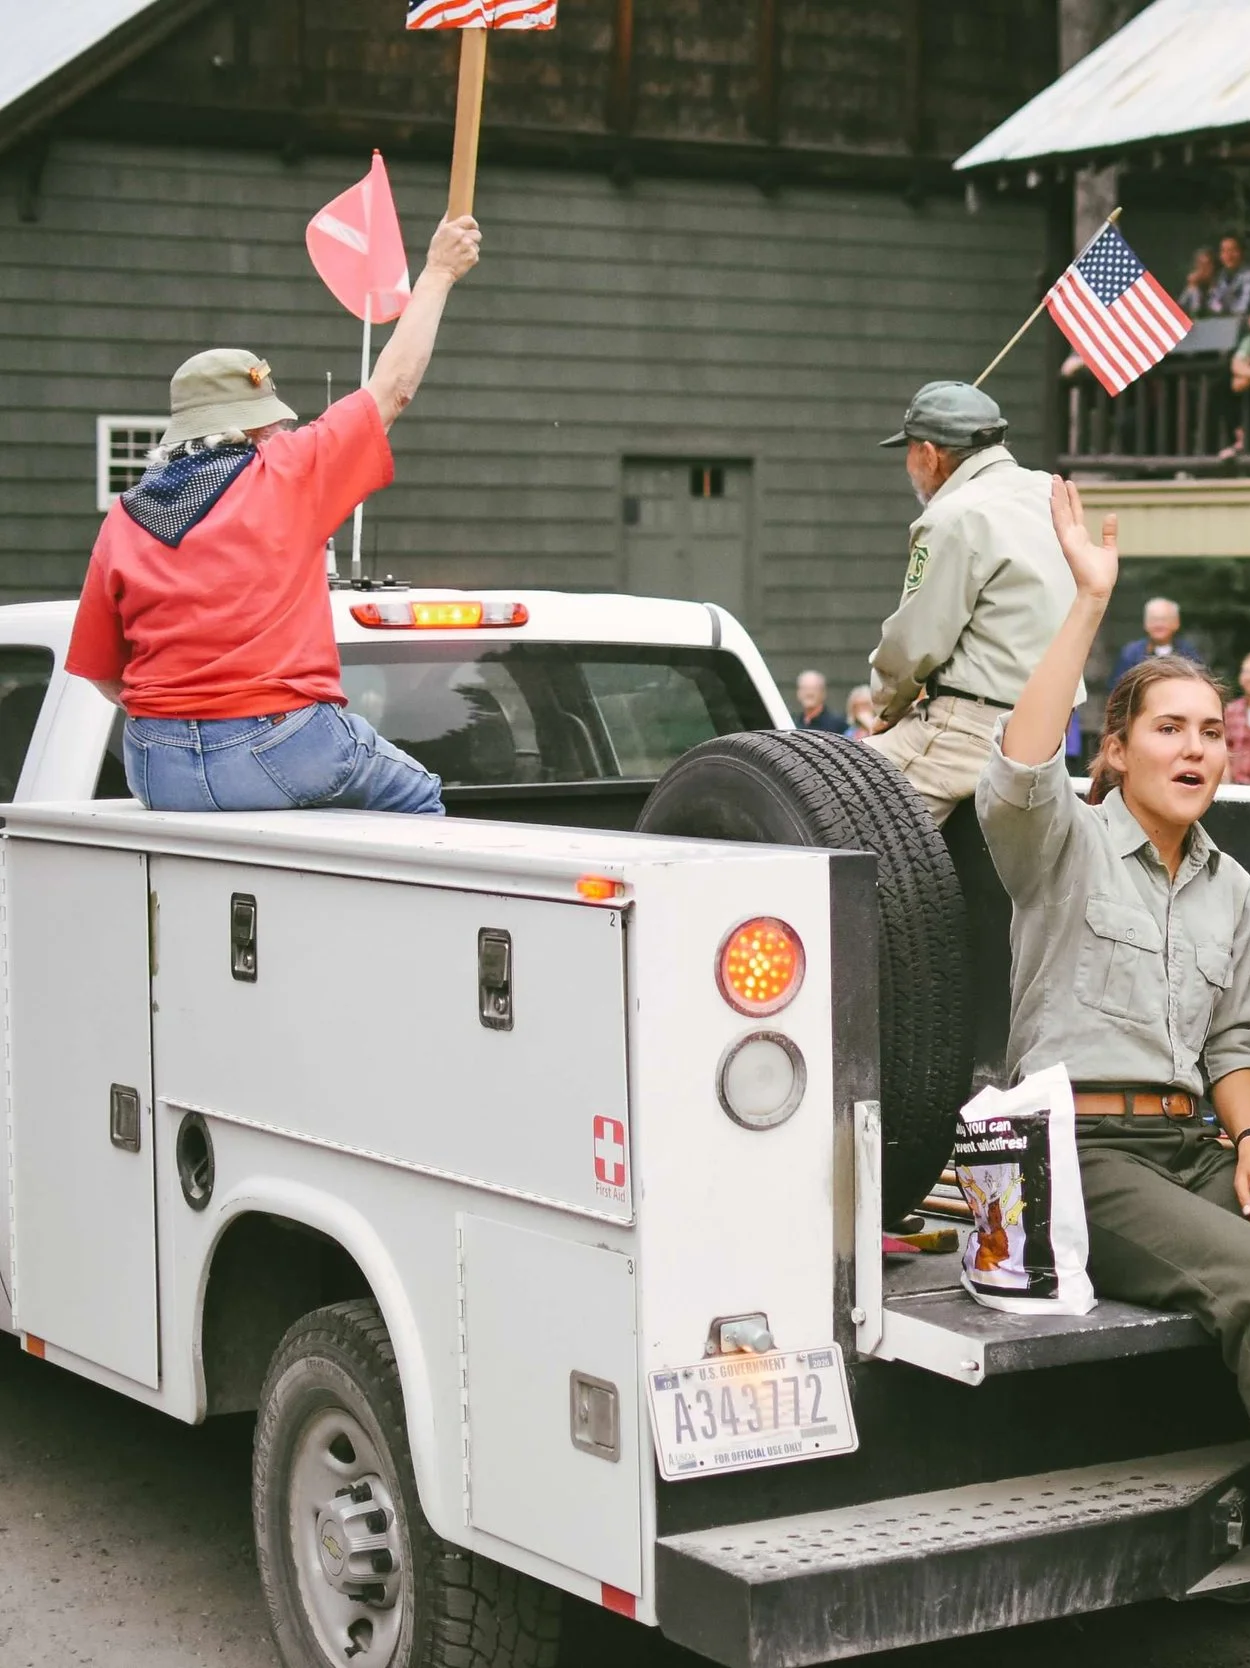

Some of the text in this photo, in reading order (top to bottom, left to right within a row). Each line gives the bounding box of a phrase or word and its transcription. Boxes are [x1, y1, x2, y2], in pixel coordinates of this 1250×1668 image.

[609, 911, 616, 927] 2
[989, 1120, 1012, 1132] can
[977, 1136, 1028, 1152] wildfires!
[596, 1182, 625, 1202] First Aid
[627, 1259, 634, 1275] 3
[699, 1356, 787, 1381] U.S. GOVERNMENT
[674, 1373, 828, 1444] A343772
[714, 1441, 803, 1465] FOR OFFICIAL USE ONLY
